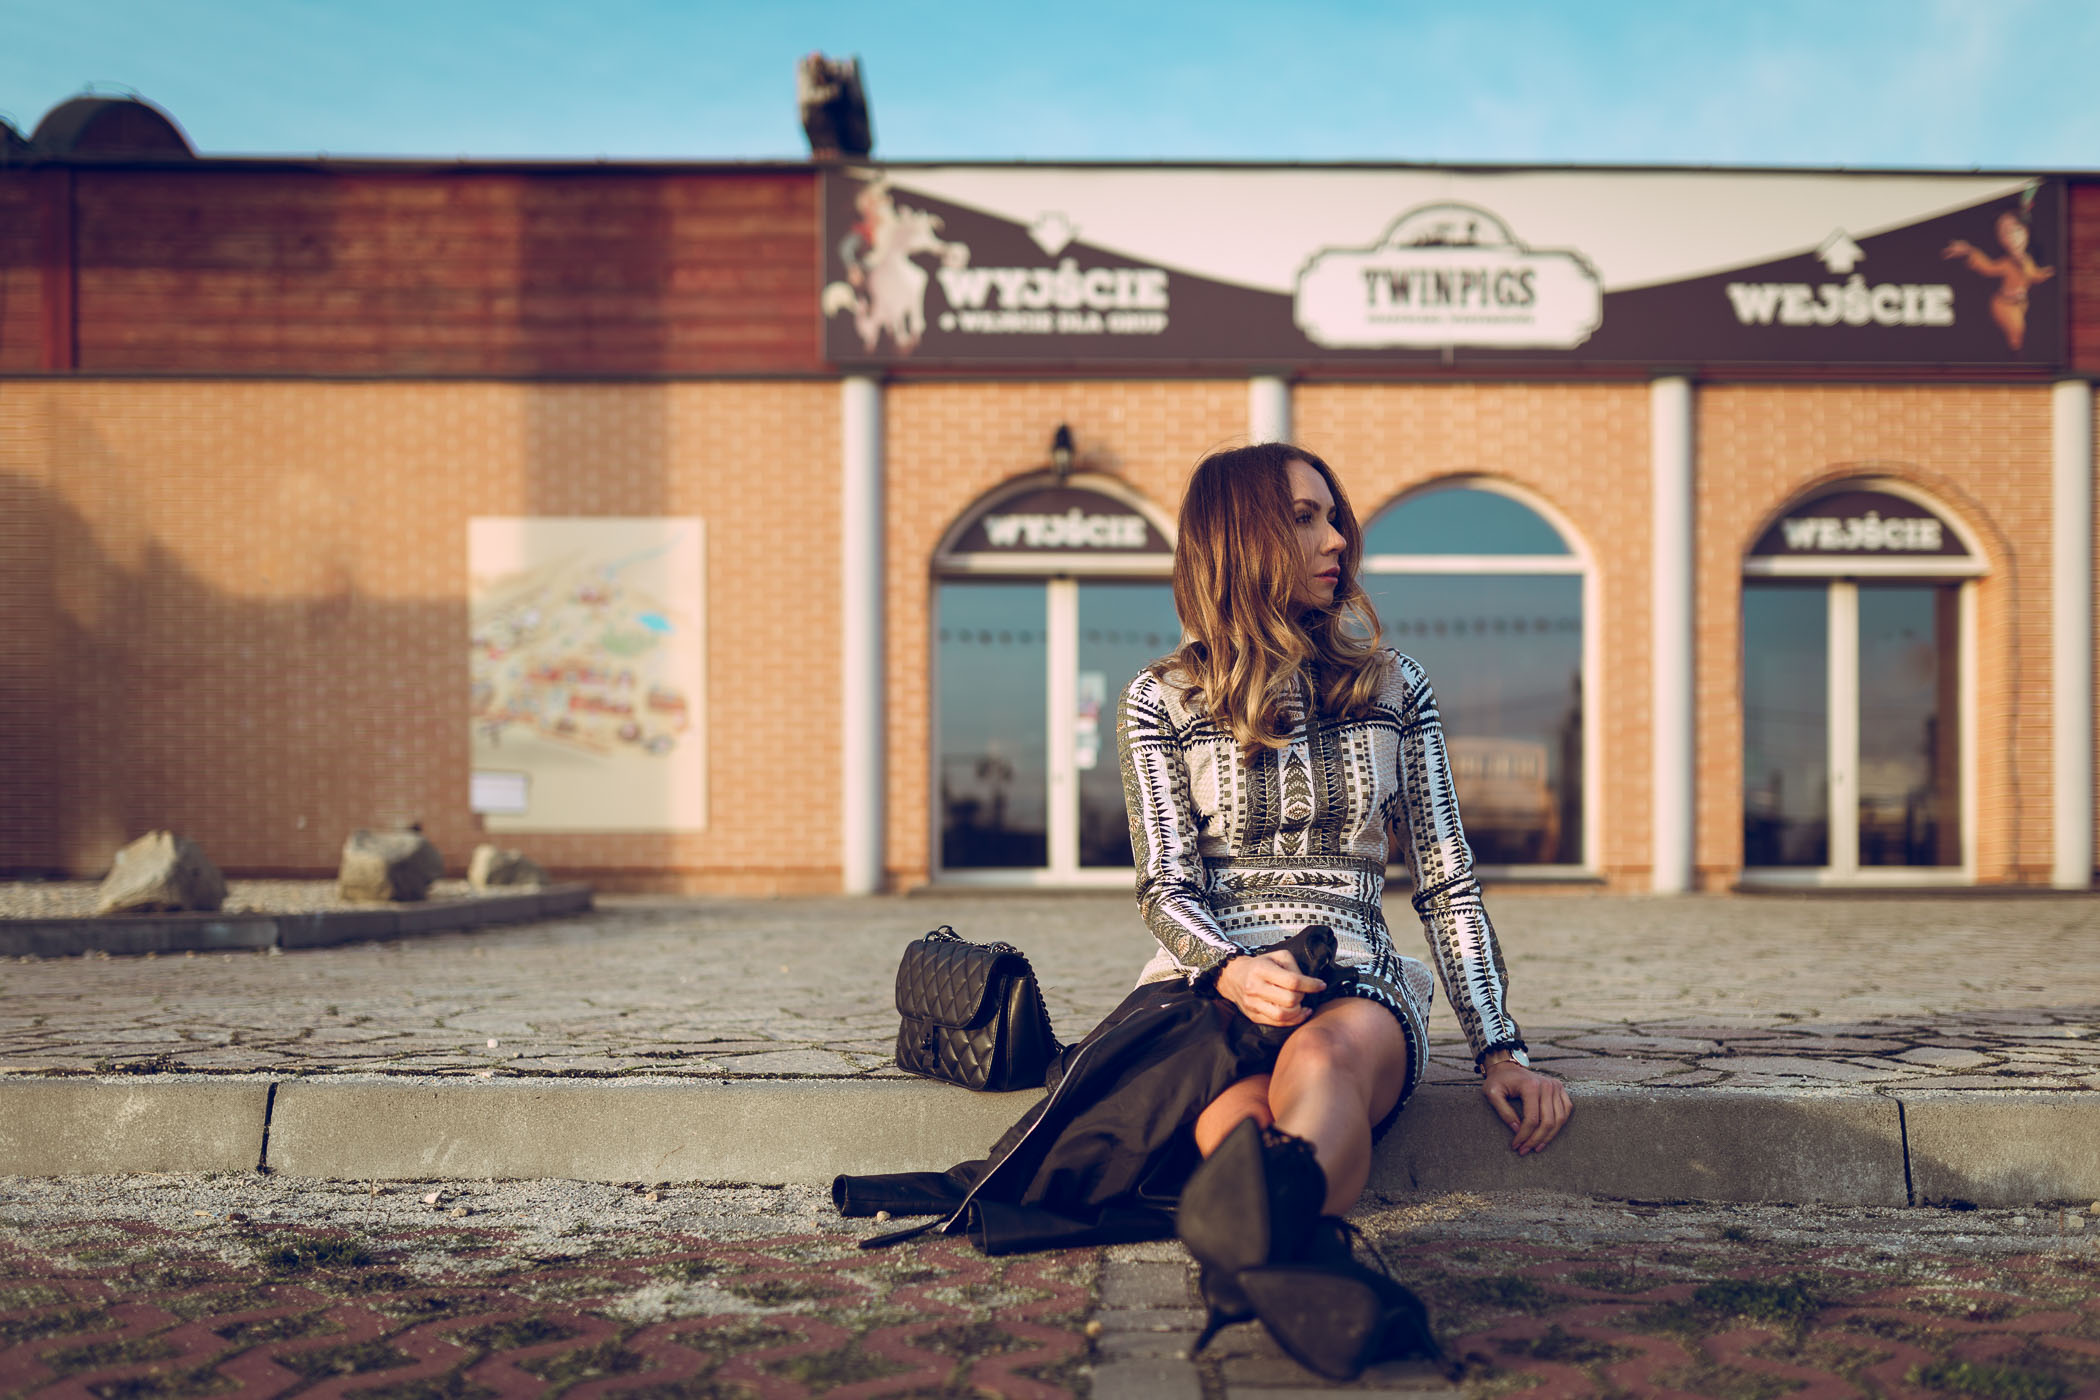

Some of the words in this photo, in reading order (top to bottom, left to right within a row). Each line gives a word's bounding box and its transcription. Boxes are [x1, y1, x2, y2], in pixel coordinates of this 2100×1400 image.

[937, 258, 1169, 309] WYJŚCIE
[1364, 269, 1536, 306] TWINPIGS
[1727, 273, 1955, 326] WEJŚCIE
[1783, 510, 1942, 549] WEJŚCIE
